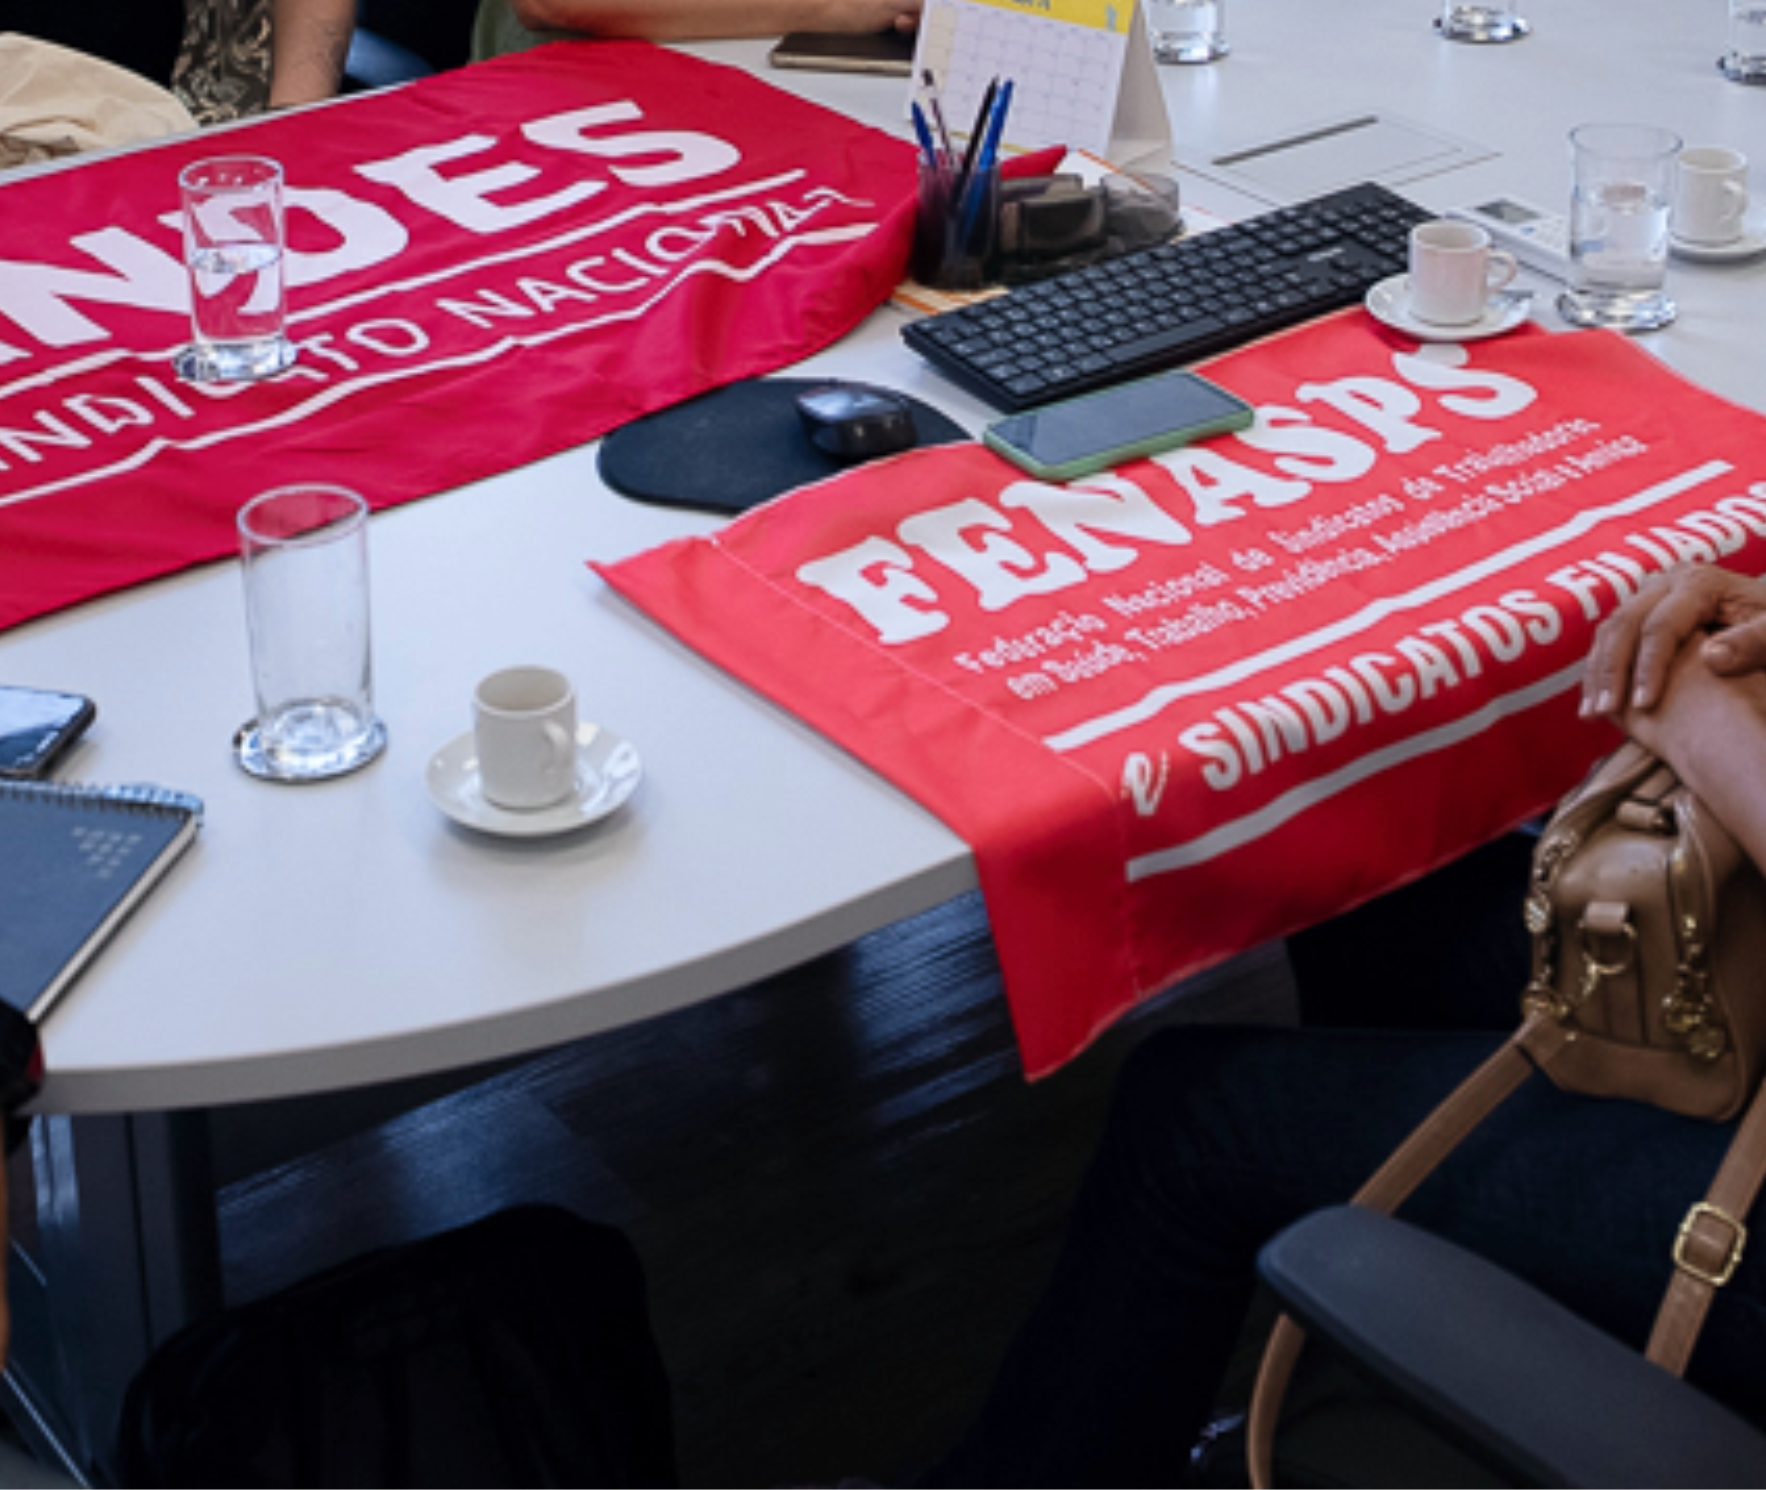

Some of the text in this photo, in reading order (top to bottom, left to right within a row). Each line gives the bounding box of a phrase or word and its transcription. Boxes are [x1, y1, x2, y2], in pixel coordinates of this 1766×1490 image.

[795, 342, 1538, 644] FENASPS
[1101, 560, 1230, 619] Nacional
[1119, 750, 1170, 817] e
[1177, 587, 1564, 792] SINDICATOS
